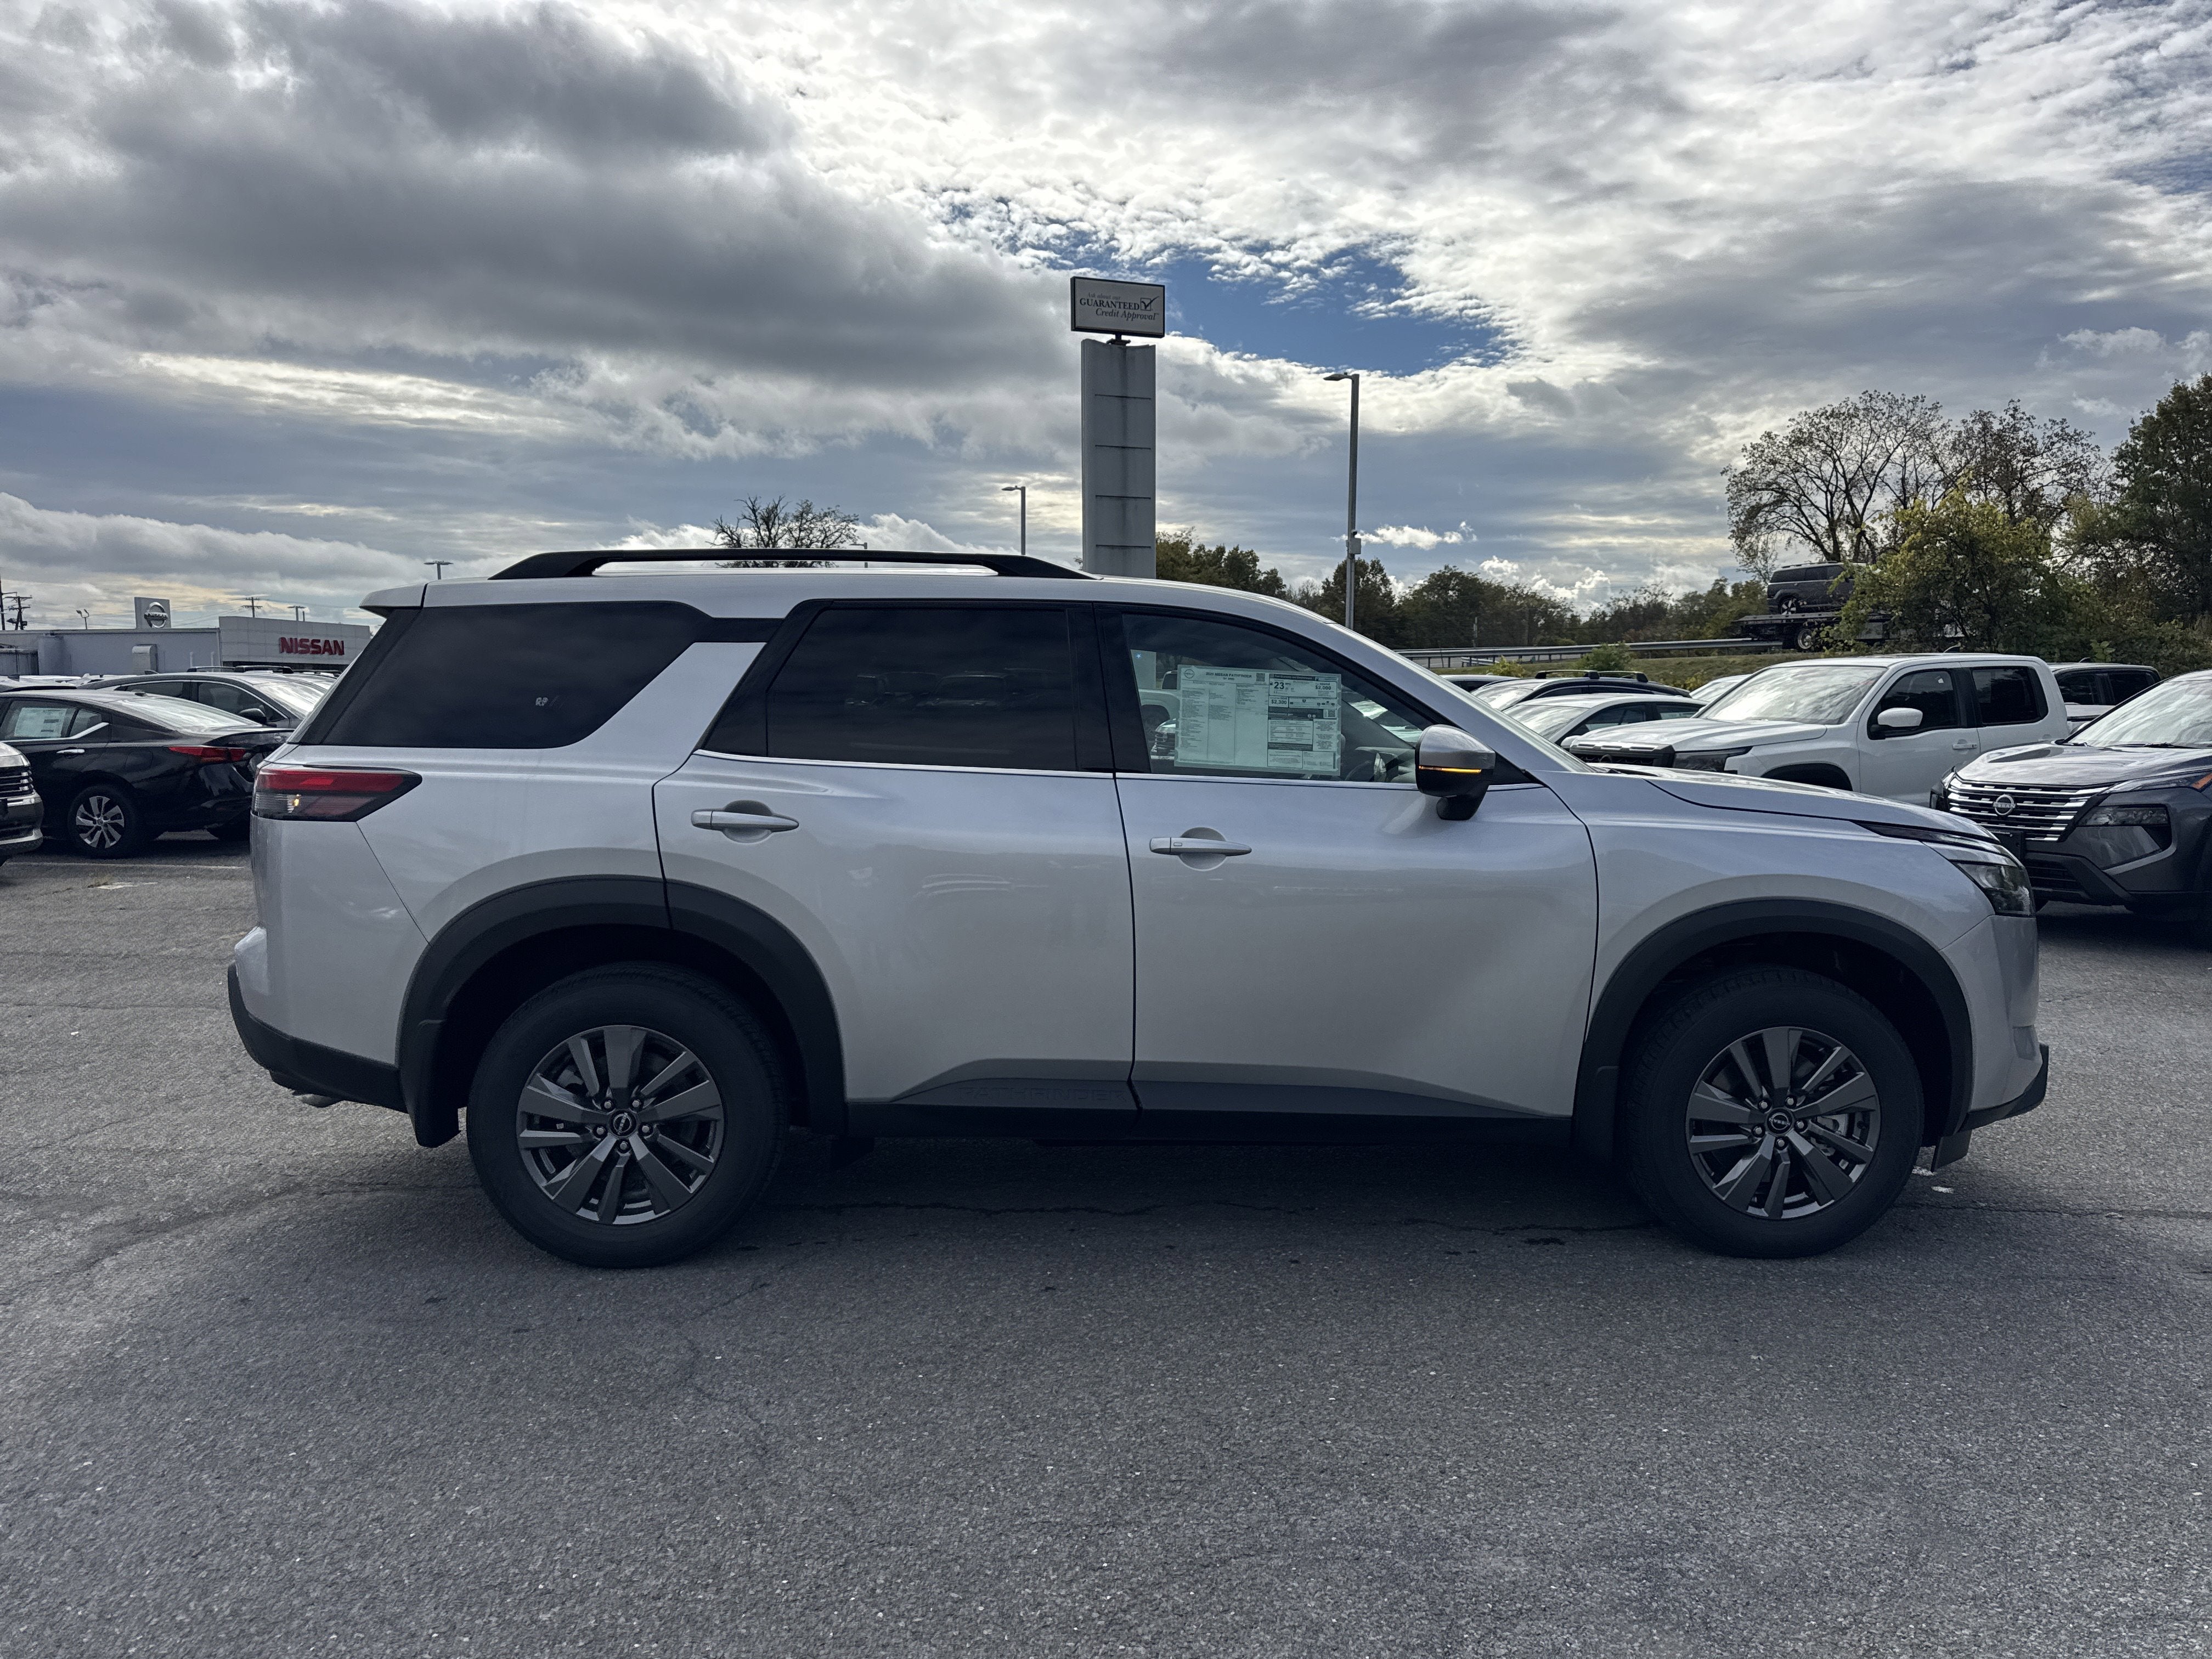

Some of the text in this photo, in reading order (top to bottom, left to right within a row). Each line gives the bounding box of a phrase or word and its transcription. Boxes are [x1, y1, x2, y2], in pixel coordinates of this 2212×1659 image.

[1080, 298, 1139, 310] GUARANTEED
[1096, 308, 1119, 318] Credit
[279, 637, 345, 656] NISSAN
[1274, 681, 1284, 690] 23
[959, 1087, 1126, 1101] PATHFINDER
